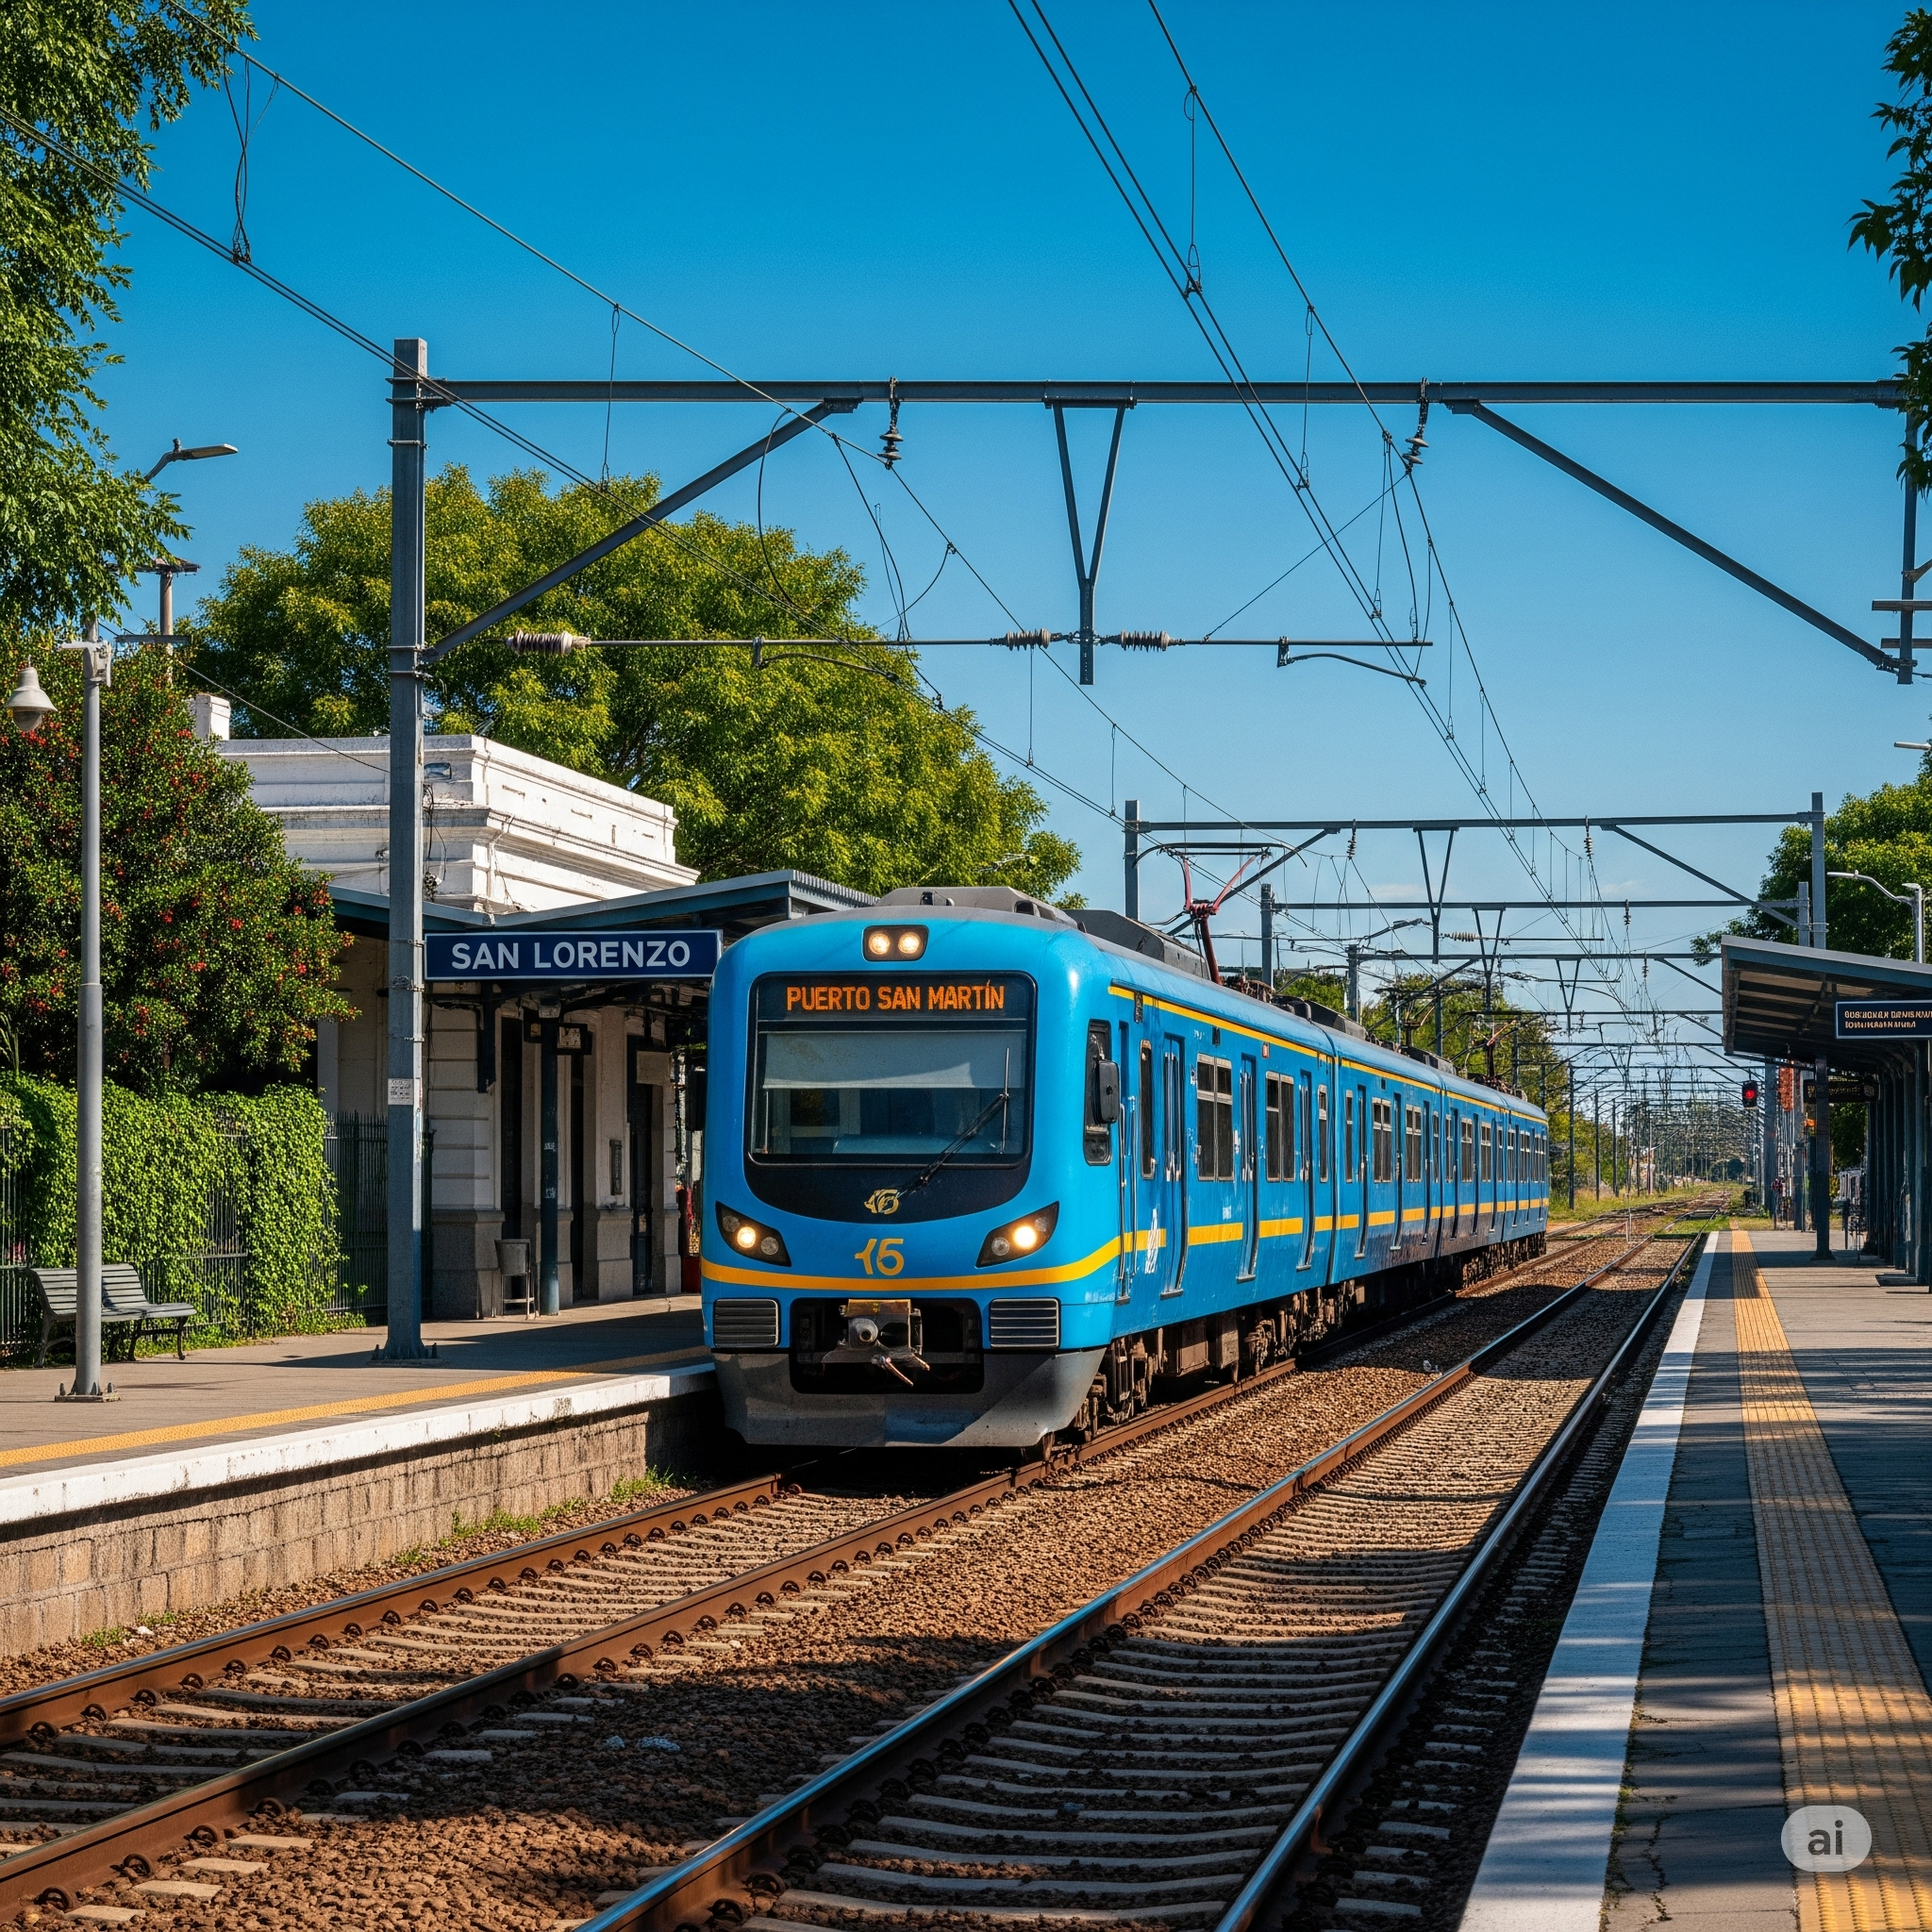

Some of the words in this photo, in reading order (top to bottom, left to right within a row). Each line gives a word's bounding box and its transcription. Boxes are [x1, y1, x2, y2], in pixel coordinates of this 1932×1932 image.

[451, 942, 519, 970] SAN
[534, 940, 691, 969] LORENZO
[786, 986, 870, 1010] PUERTO
[877, 986, 921, 1010] SAN
[927, 979, 1005, 1010] MARTÍN
